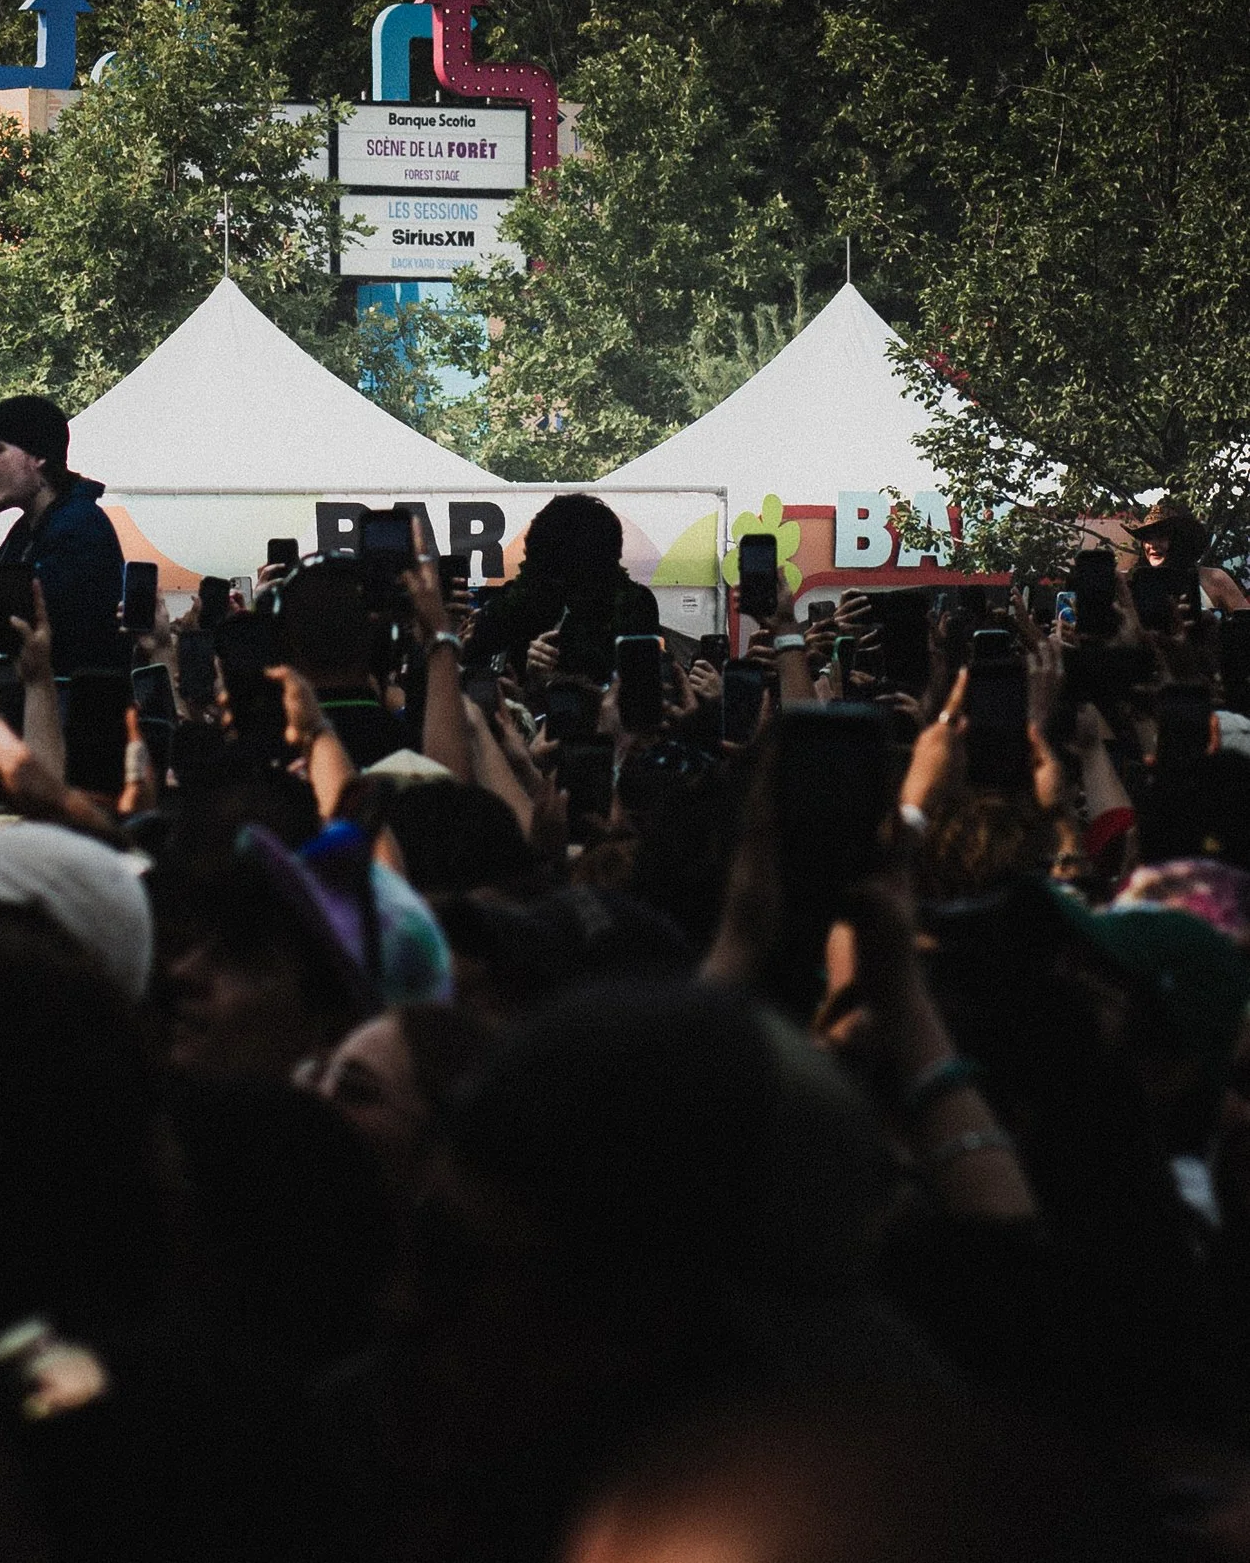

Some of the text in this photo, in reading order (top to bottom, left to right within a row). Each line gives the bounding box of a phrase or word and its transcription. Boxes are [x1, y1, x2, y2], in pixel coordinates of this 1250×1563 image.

[388, 112, 476, 130] Banque Scotia
[366, 136, 498, 159] SCÈNE DE LA FORÊT
[404, 168, 460, 181] FOREST STAGE
[388, 201, 478, 220] LES SESSIONS
[392, 228, 475, 247] SiriusXM
